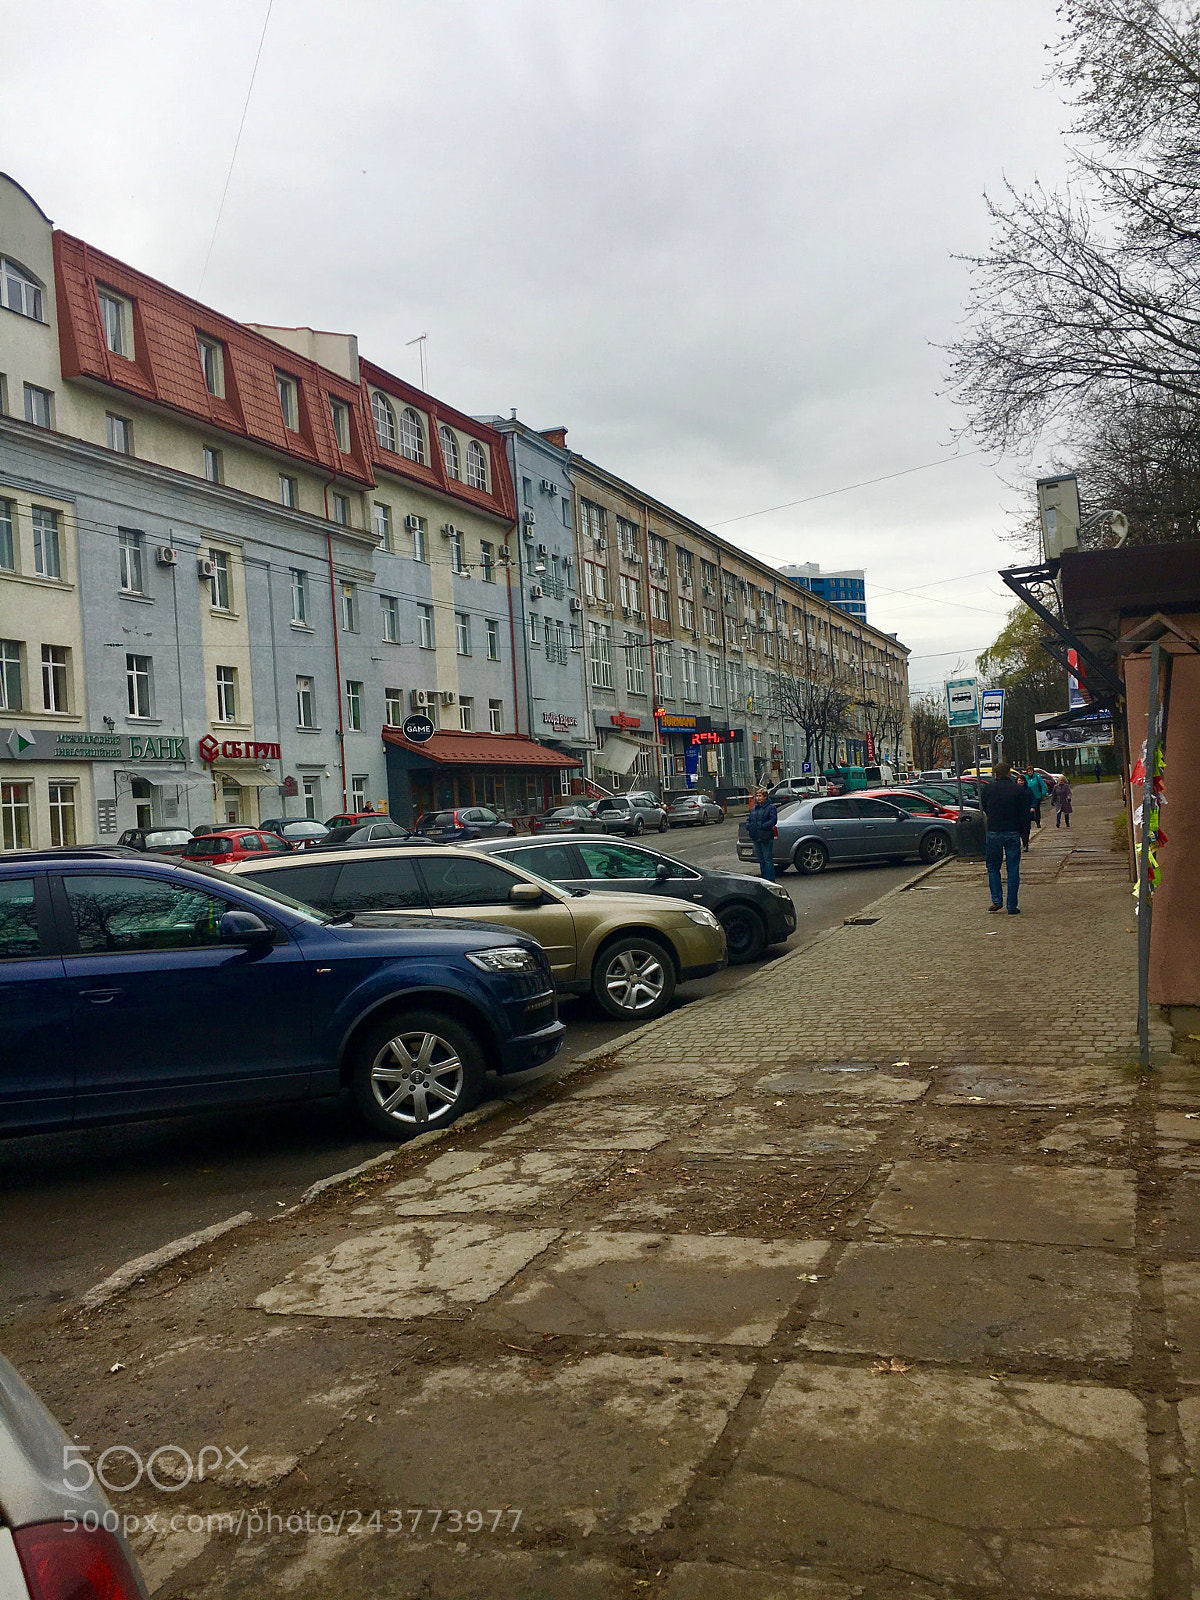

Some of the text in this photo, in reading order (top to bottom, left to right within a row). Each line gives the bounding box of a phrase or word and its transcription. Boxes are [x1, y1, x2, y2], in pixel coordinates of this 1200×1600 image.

[406, 725, 431, 733] GAME
[128, 736, 186, 759] БАНК
[222, 740, 281, 760] СБ ГРУП
